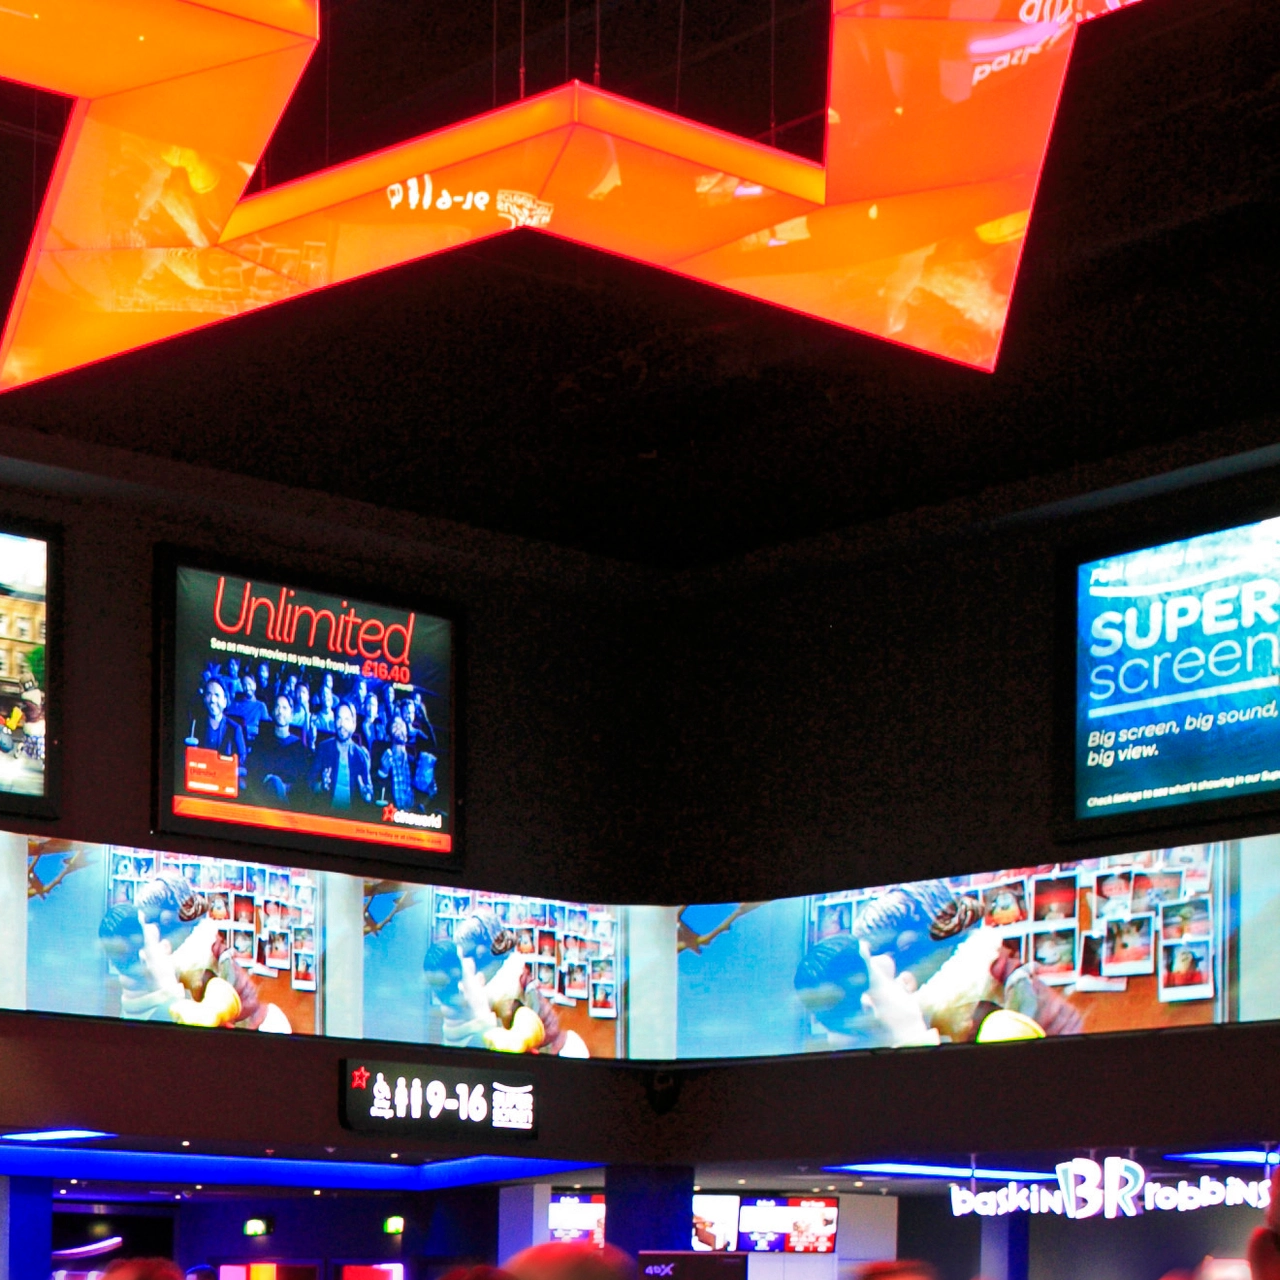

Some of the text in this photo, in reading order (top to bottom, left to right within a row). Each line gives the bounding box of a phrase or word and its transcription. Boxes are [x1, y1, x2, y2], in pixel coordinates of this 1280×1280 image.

[213, 576, 415, 666] Unlimited
[1090, 578, 1280, 658] SUPER
[362, 660, 410, 684] £16.40
[1089, 630, 1280, 701] screen
[1087, 700, 1279, 748] Big screen, big sound,
[1087, 743, 1159, 768] big view.
[426, 1080, 488, 1122] 9-16
[1055, 1156, 1146, 1219] BR
[645, 1263, 675, 1277] 4DX
